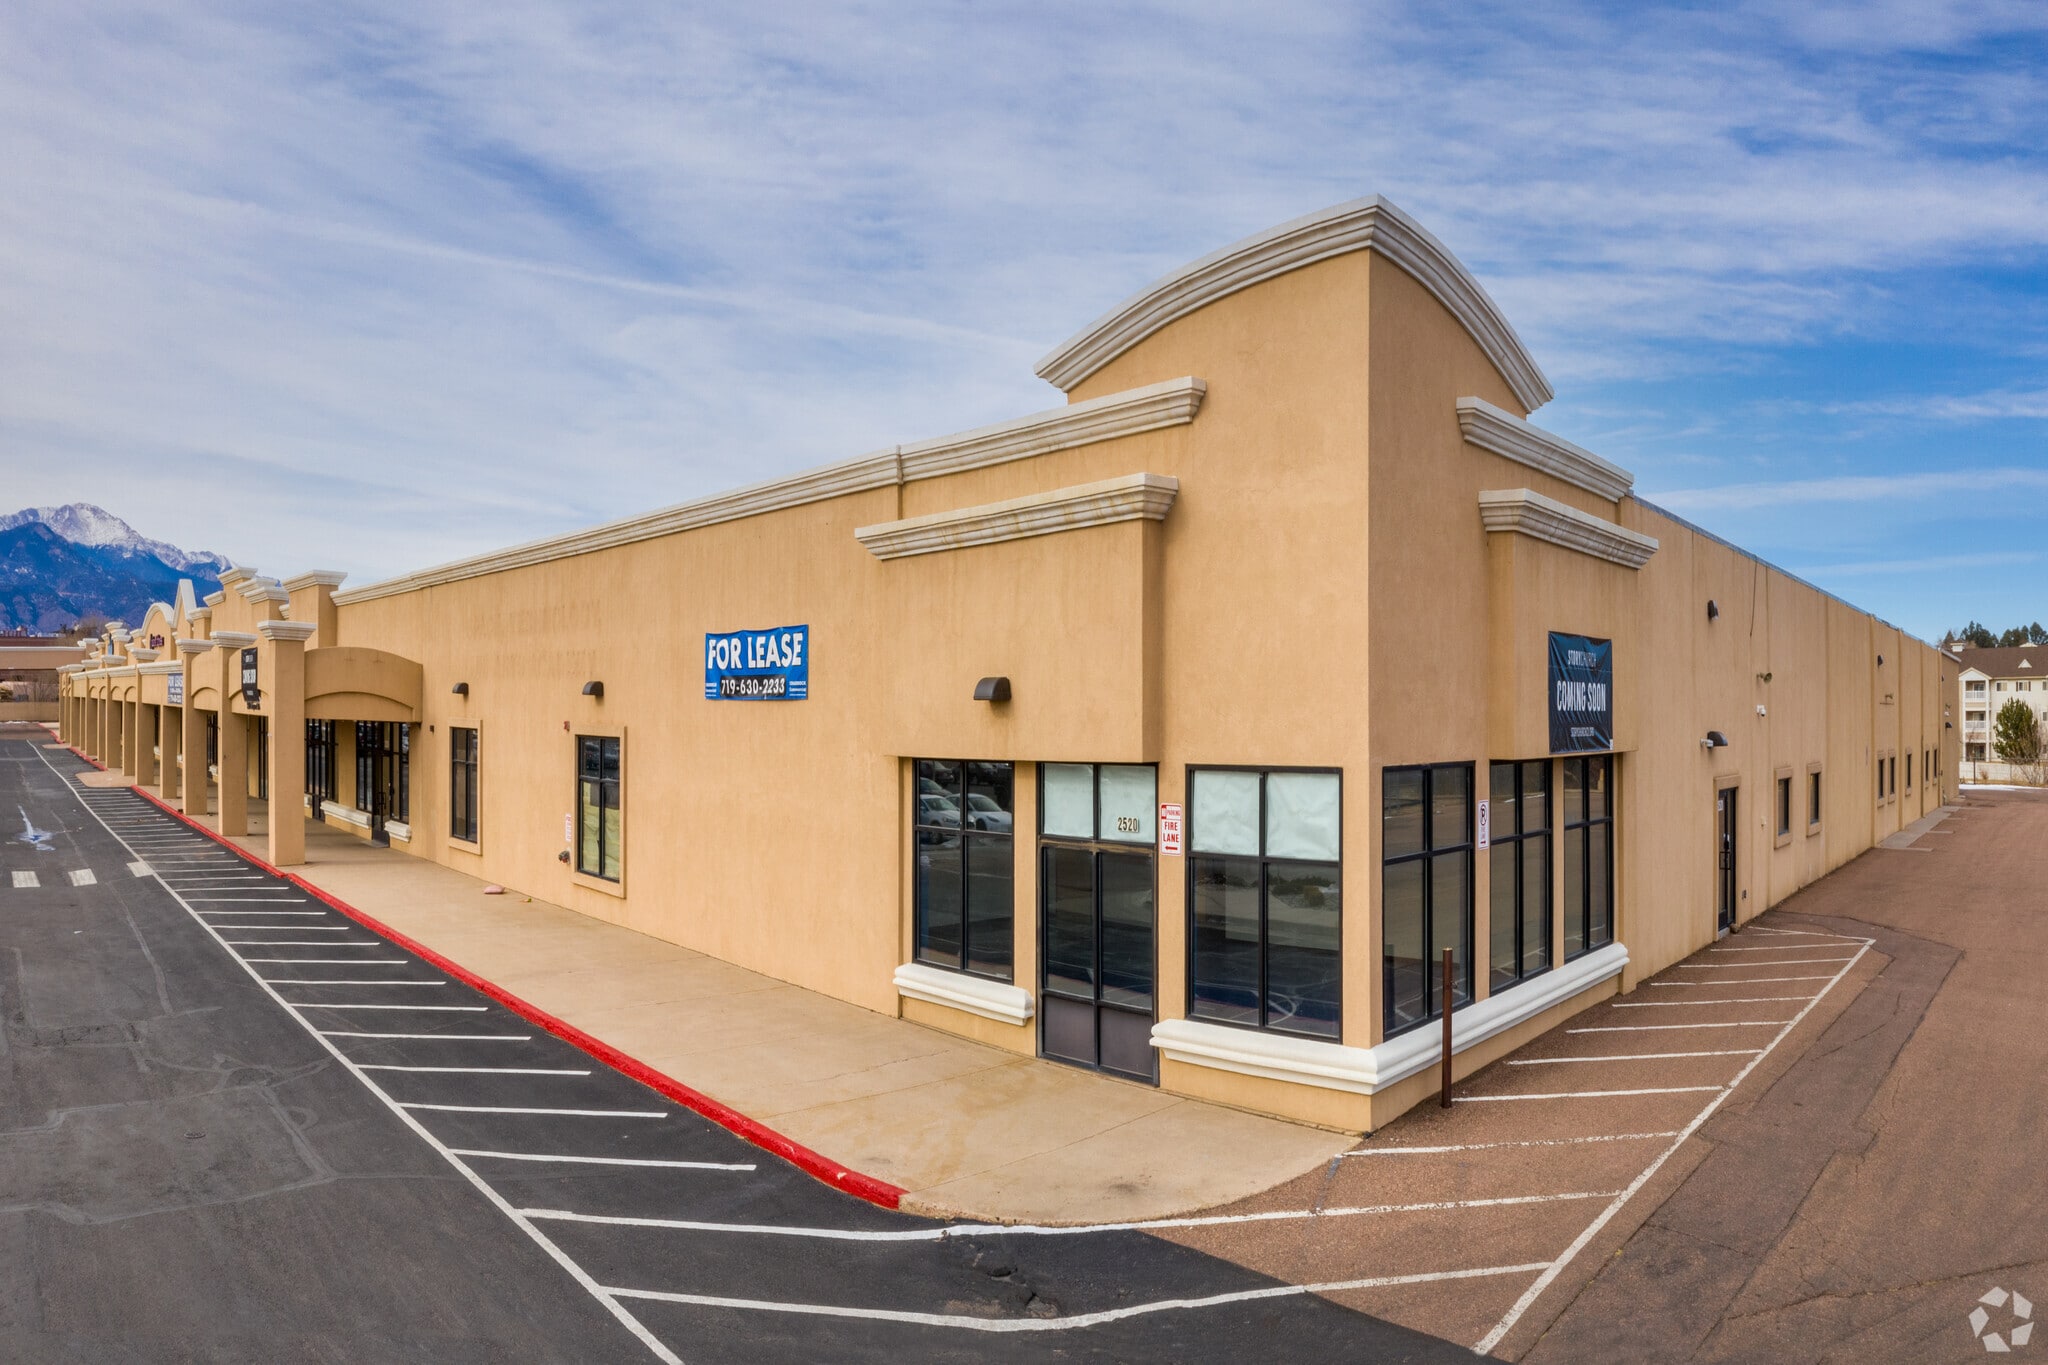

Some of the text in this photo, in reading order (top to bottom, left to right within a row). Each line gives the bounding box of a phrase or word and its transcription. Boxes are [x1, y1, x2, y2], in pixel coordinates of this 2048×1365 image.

[708, 632, 803, 669] FOR LEASE
[1556, 680, 1606, 711] COMING SOON
[1118, 816, 1138, 832] 2520
[1164, 821, 1178, 831] FIRE
[1162, 833, 1179, 843] LANE
